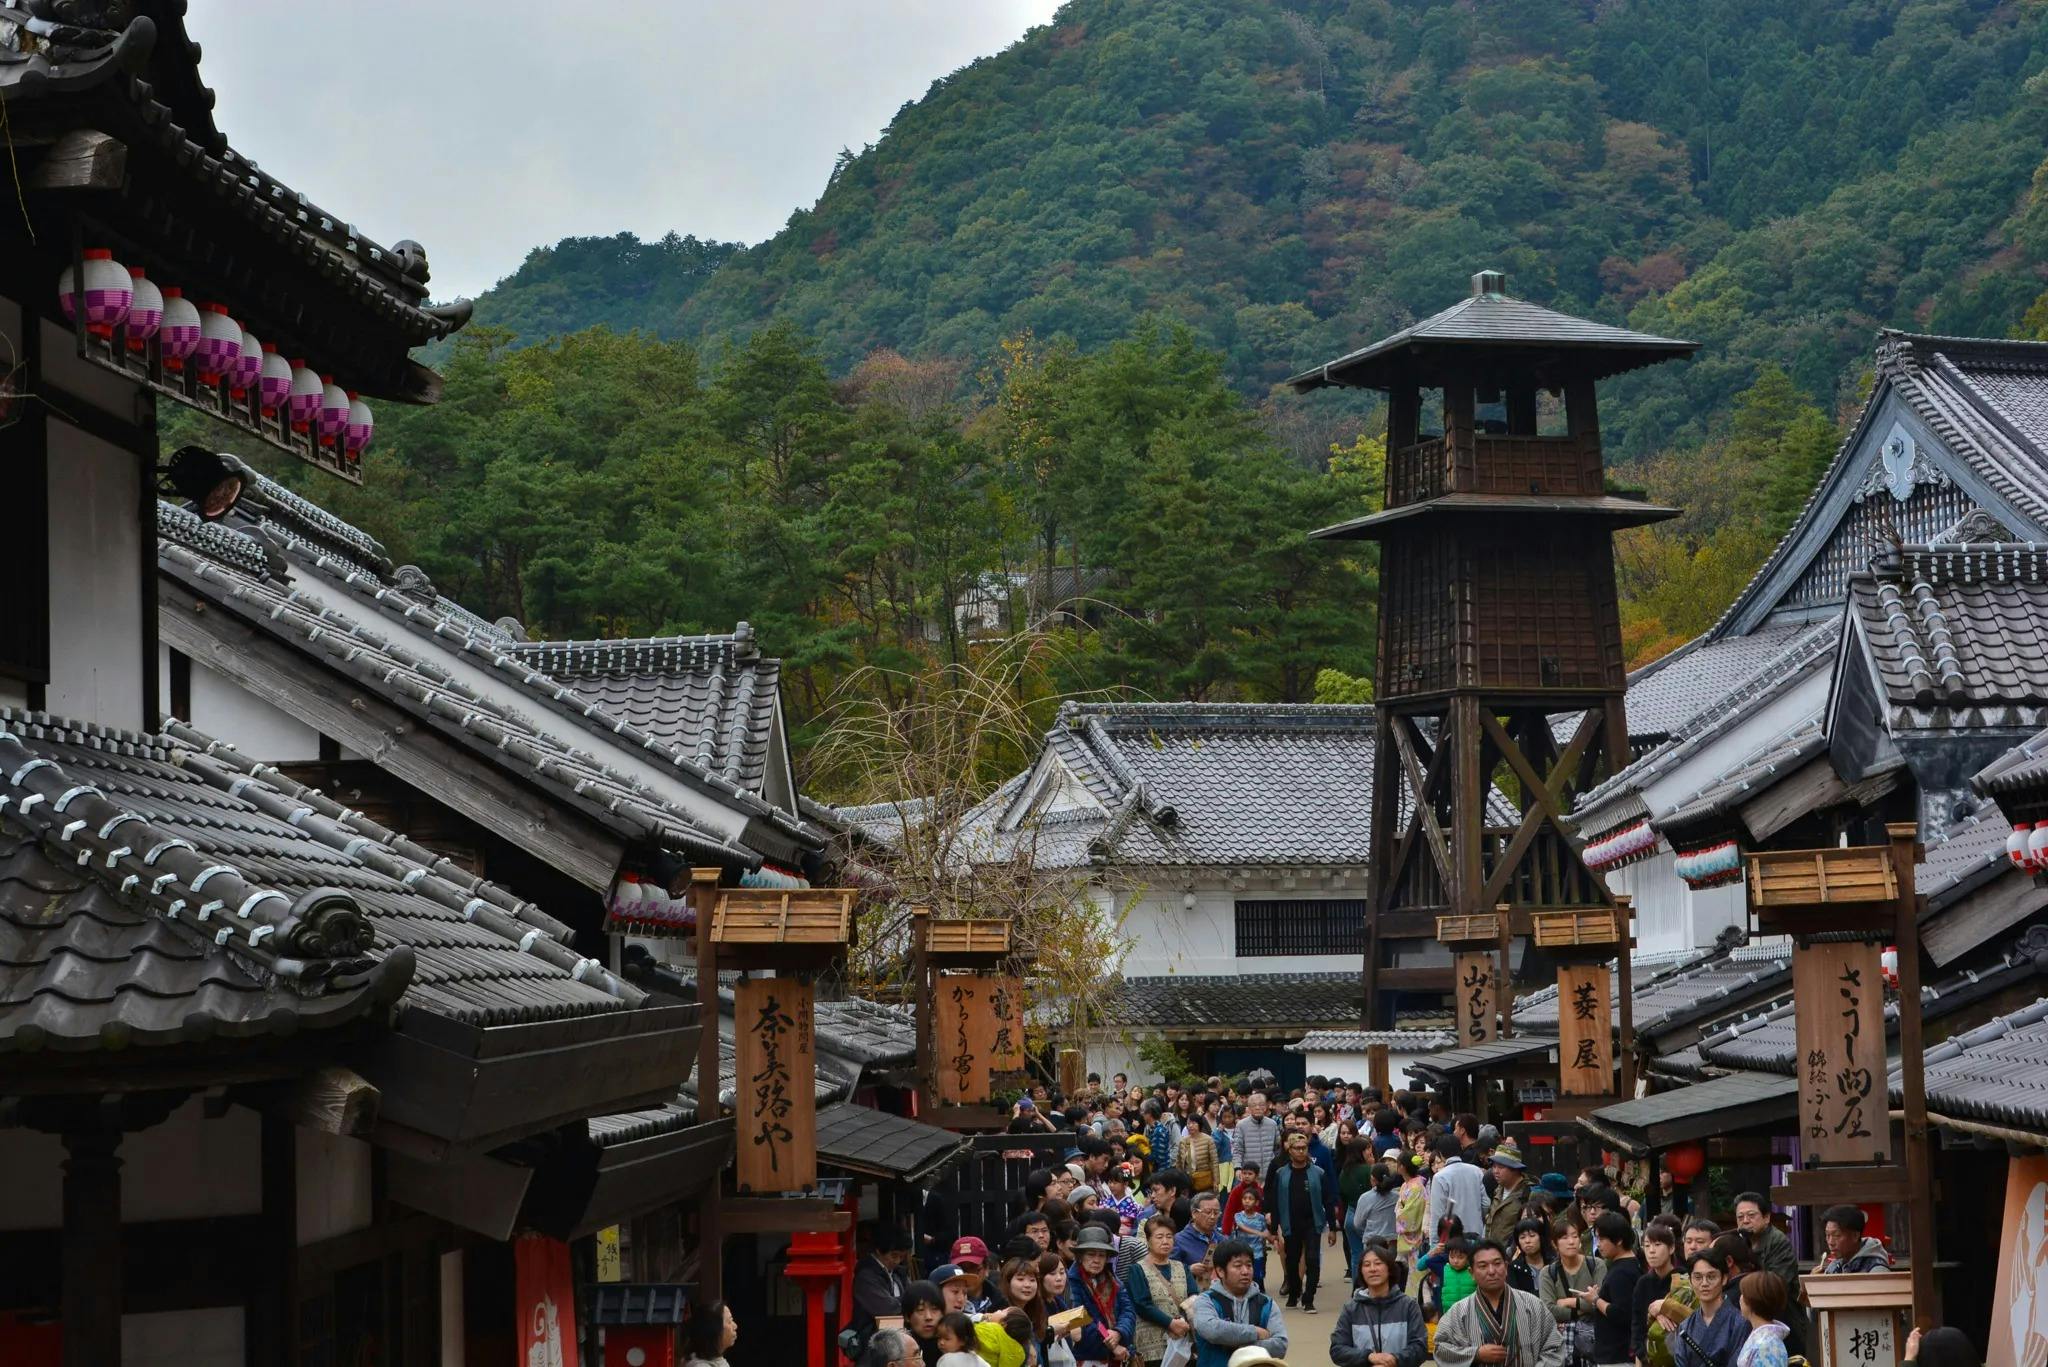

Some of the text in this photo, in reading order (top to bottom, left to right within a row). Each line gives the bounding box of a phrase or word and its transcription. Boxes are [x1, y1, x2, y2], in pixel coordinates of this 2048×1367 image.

[1463, 965, 1490, 1042] 山くじら
[1572, 981, 1600, 1070] 菱屋
[750, 995, 795, 1173] 奈美路や
[1848, 1327, 1880, 1367] 摺
